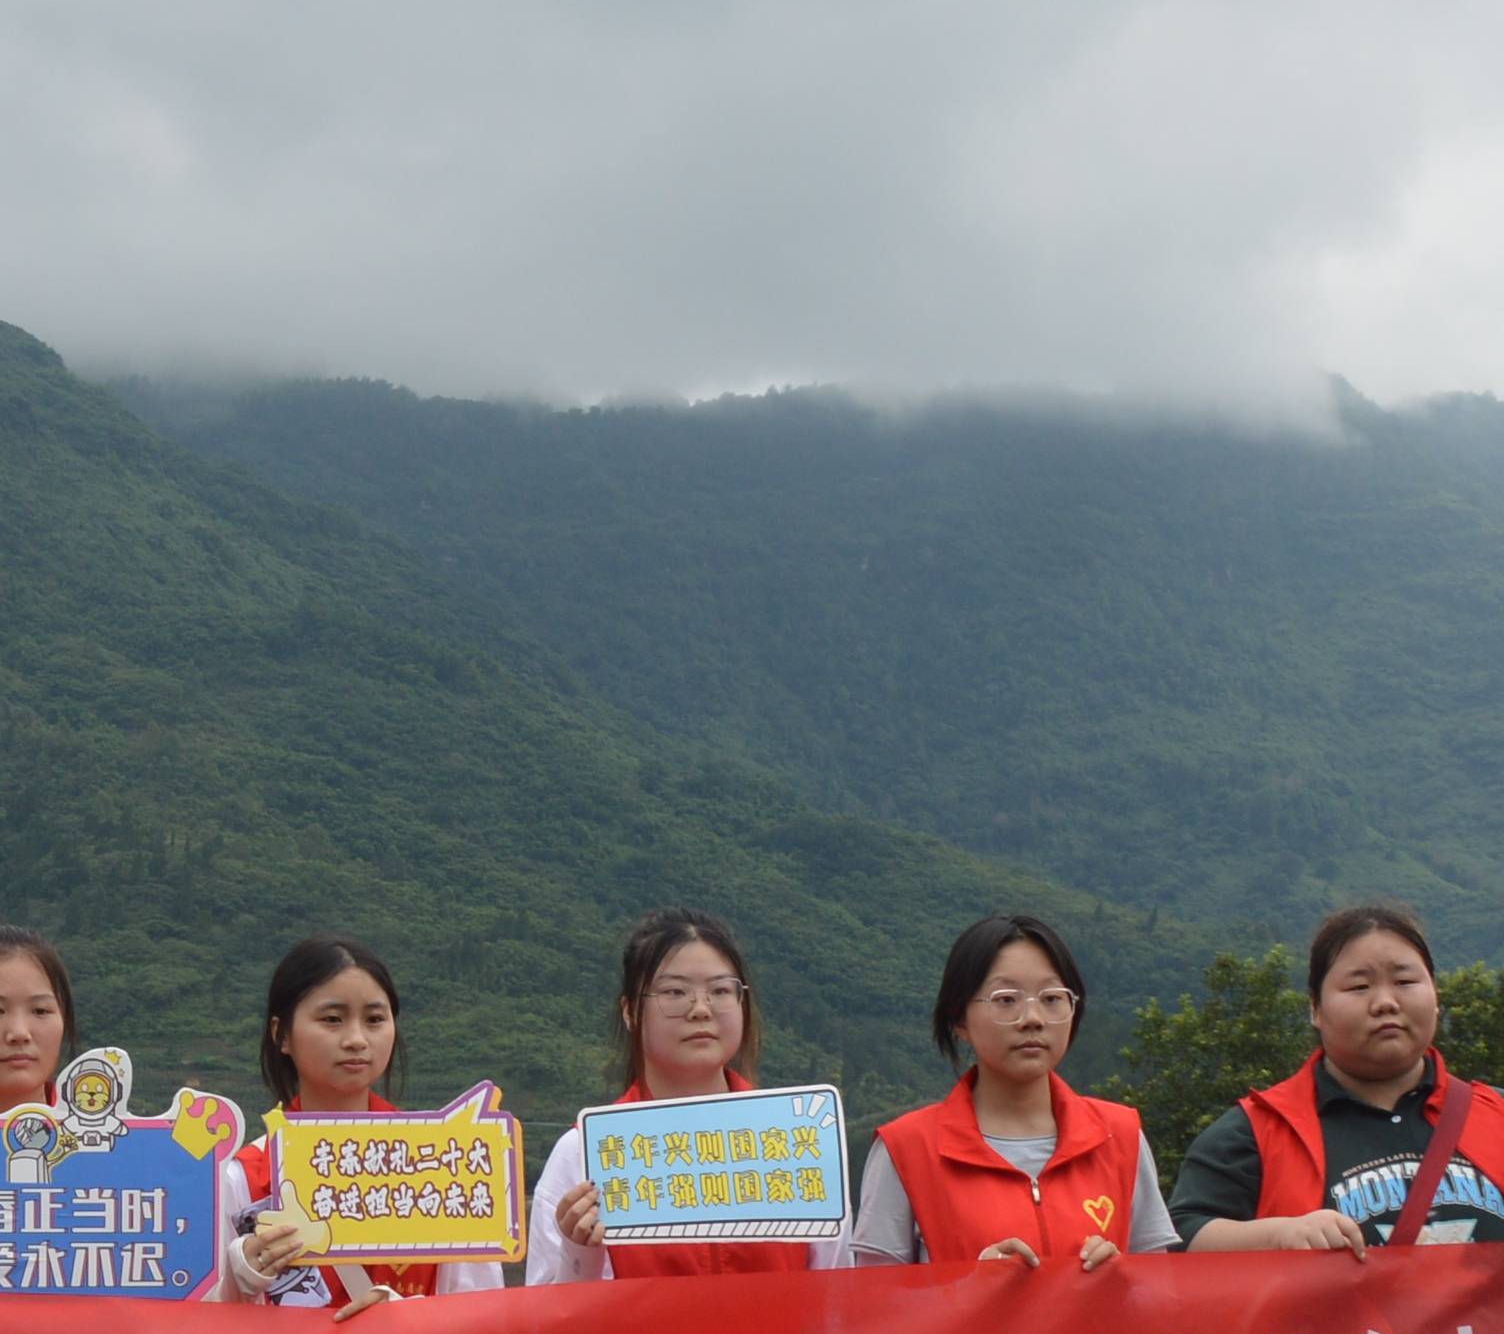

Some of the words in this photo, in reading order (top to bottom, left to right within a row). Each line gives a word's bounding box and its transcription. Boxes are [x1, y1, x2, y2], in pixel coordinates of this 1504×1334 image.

[310, 1137, 493, 1177] 青春献礼二十大
[597, 1125, 822, 1171] 青年兴则国家兴
[601, 1167, 827, 1214] 青年强则国家强
